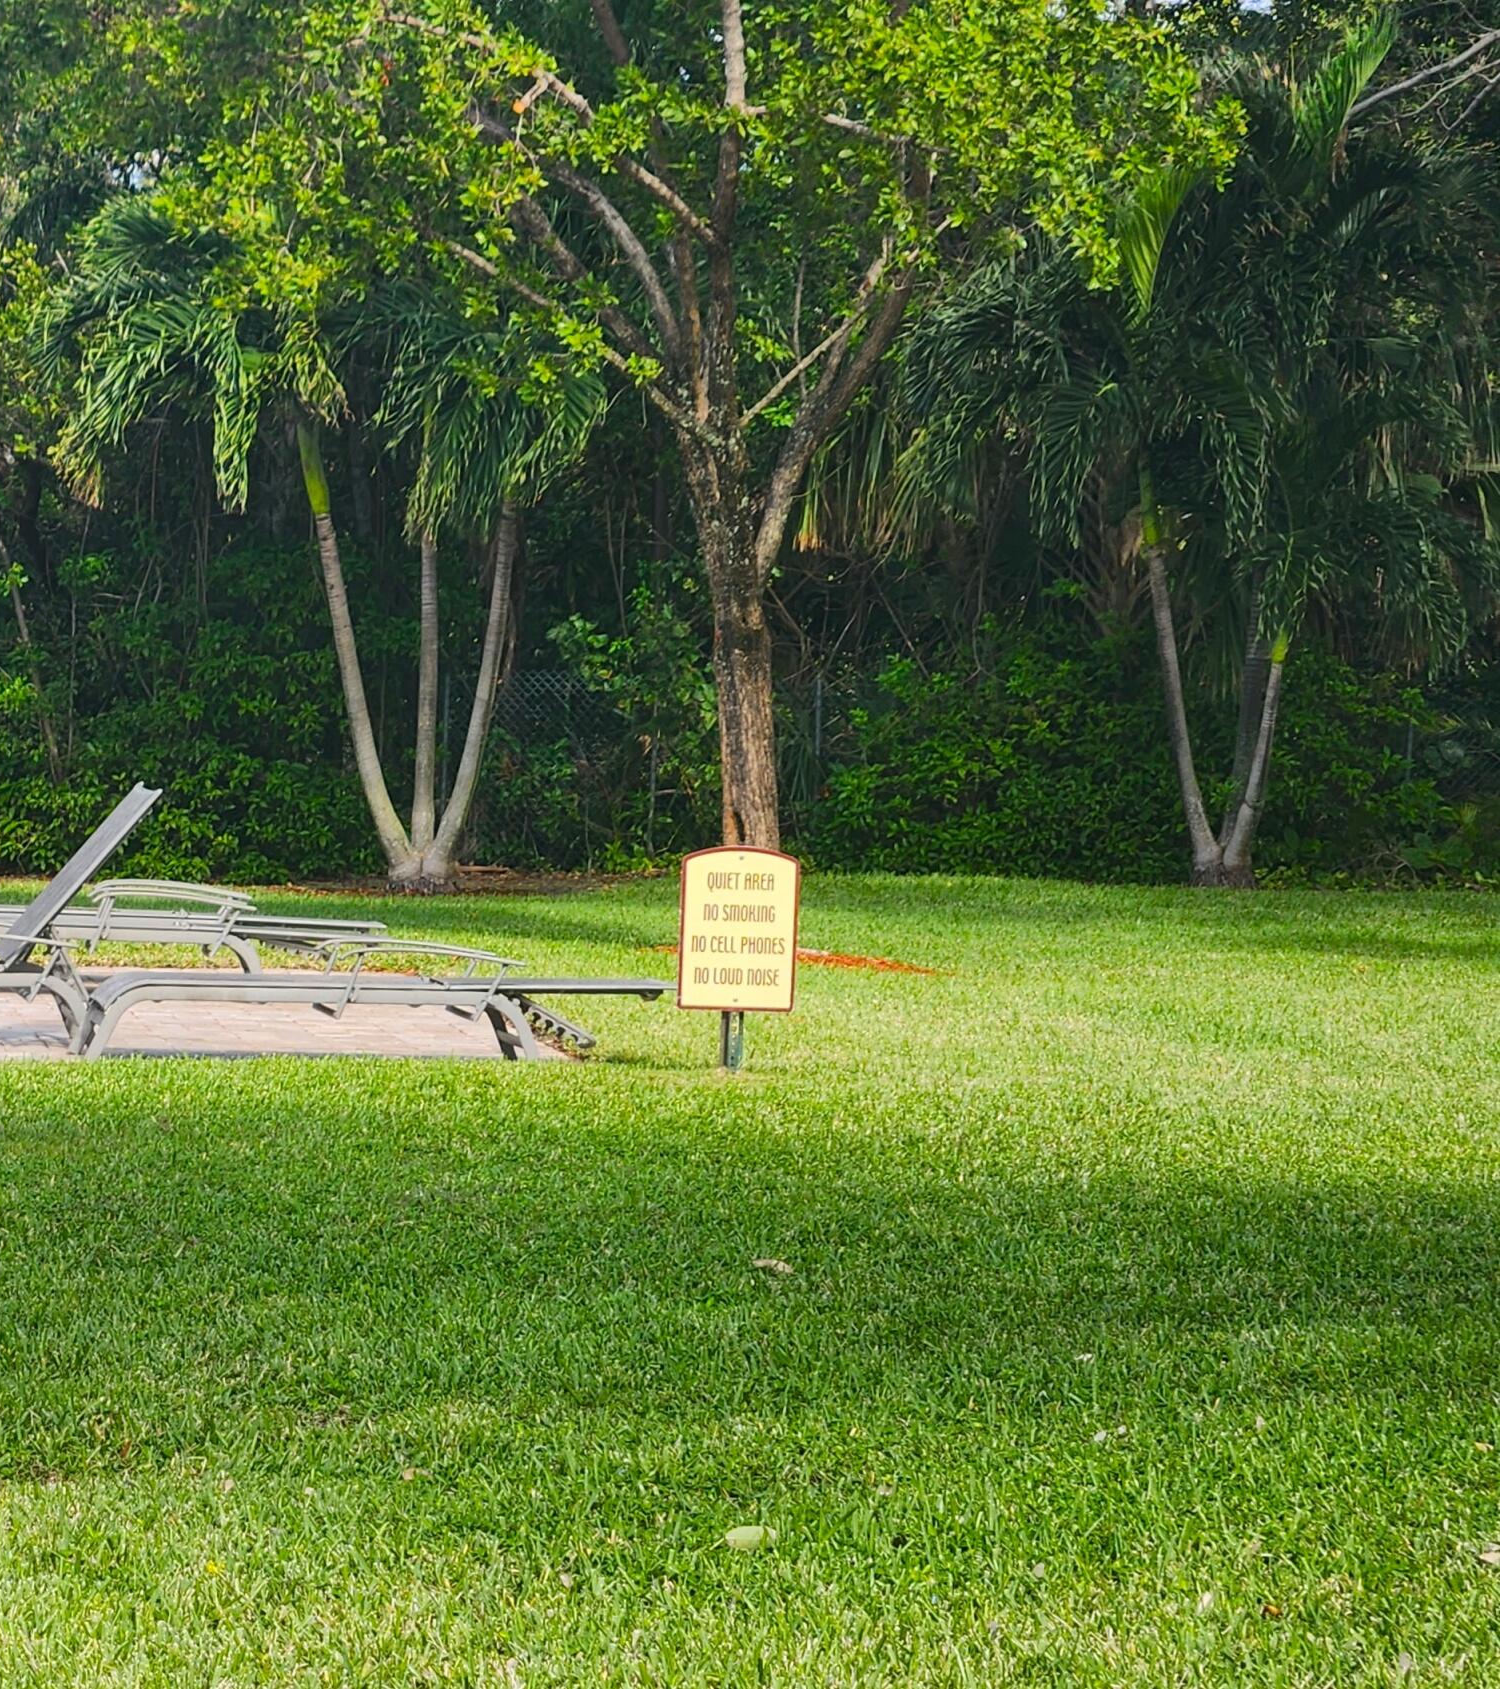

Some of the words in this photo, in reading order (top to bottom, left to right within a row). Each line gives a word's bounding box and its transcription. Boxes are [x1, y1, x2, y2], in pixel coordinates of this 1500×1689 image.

[707, 872, 740, 891] QUIET
[744, 873, 775, 891] AREA
[703, 904, 718, 921] NO
[723, 904, 775, 923] SMOKING
[691, 935, 706, 953] NO
[711, 936, 736, 953] CELL
[740, 937, 785, 954] PHONES
[694, 967, 709, 984] NO
[713, 967, 743, 985] LOUD
[747, 968, 780, 987] NOISE
